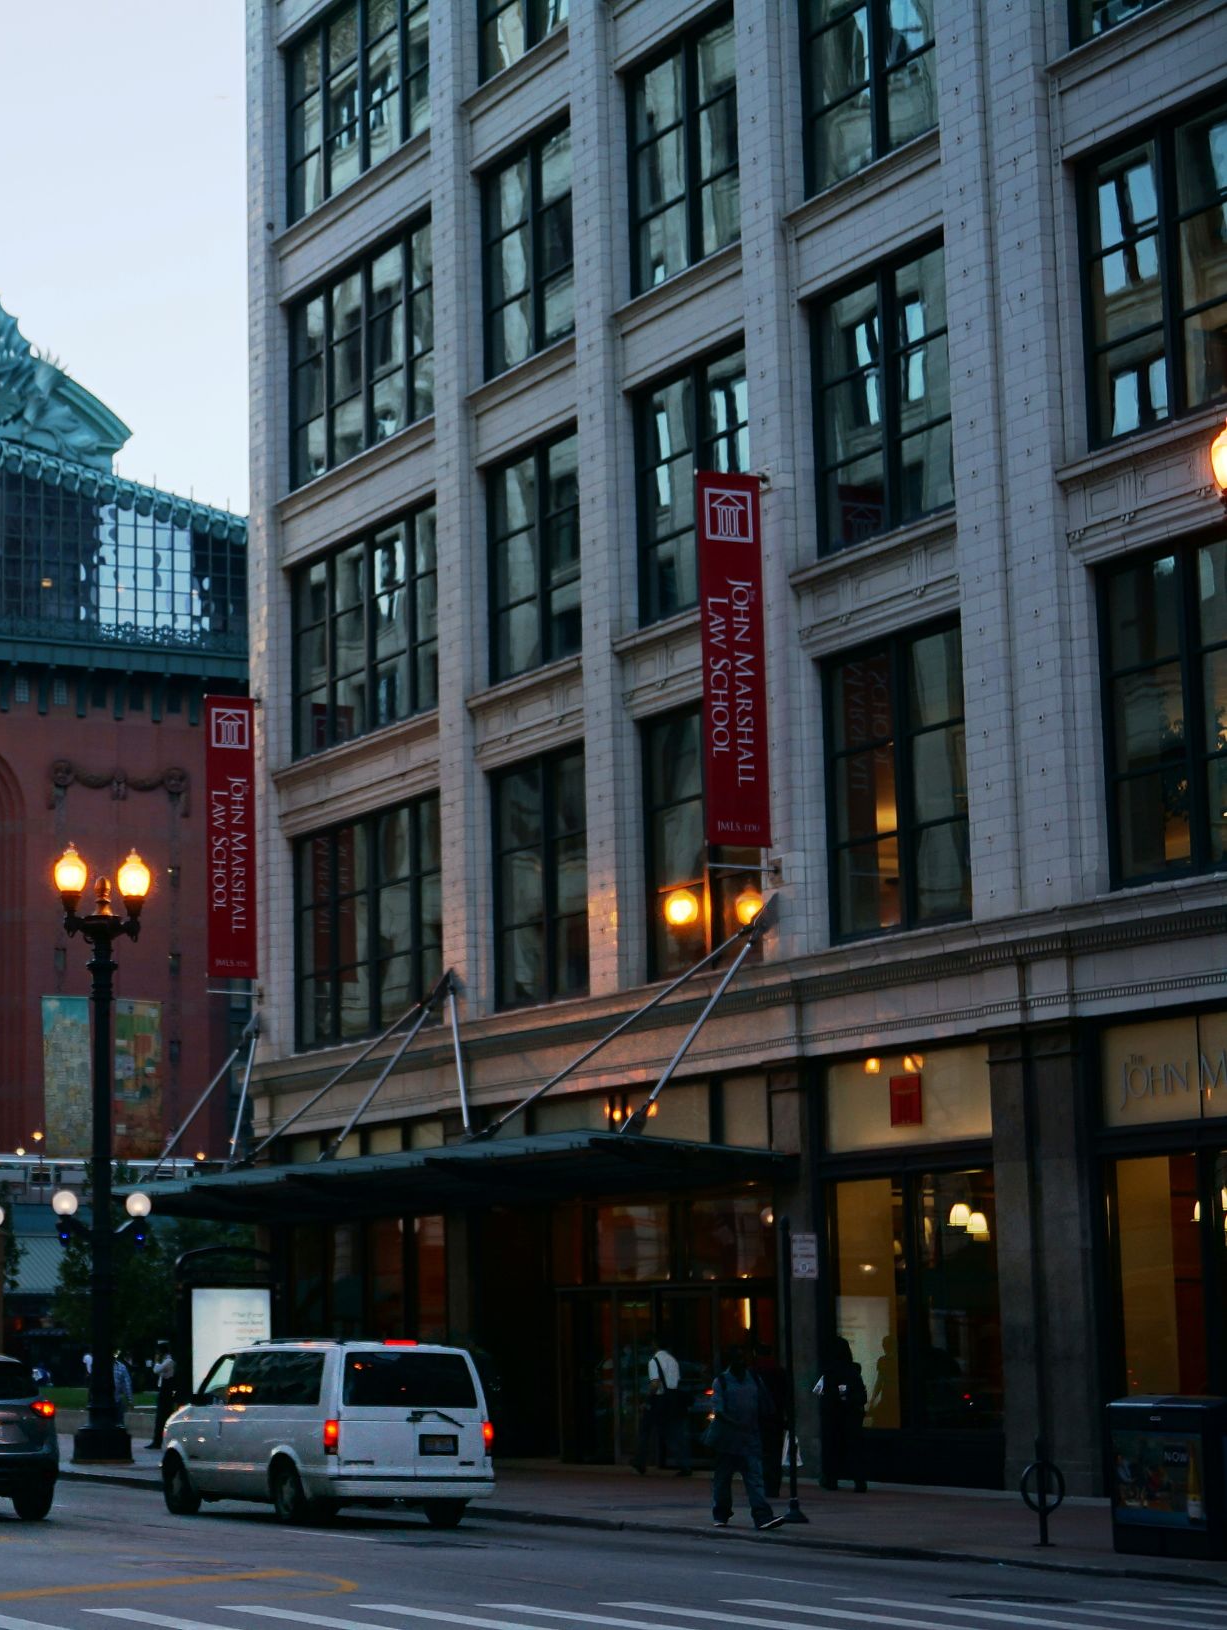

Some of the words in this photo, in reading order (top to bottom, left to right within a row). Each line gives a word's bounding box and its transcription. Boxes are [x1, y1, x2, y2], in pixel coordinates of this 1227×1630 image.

[707, 596, 728, 648] LAW
[725, 577, 752, 642] JOHN
[710, 656, 731, 758] SCHOOL
[734, 651, 755, 788] MARSHALL
[212, 789, 229, 830] LAW
[226, 775, 247, 824] JOHN
[212, 836, 229, 912] SCHOOL
[231, 832, 248, 934] MARSHALL
[1119, 1058, 1190, 1112] JOHN
